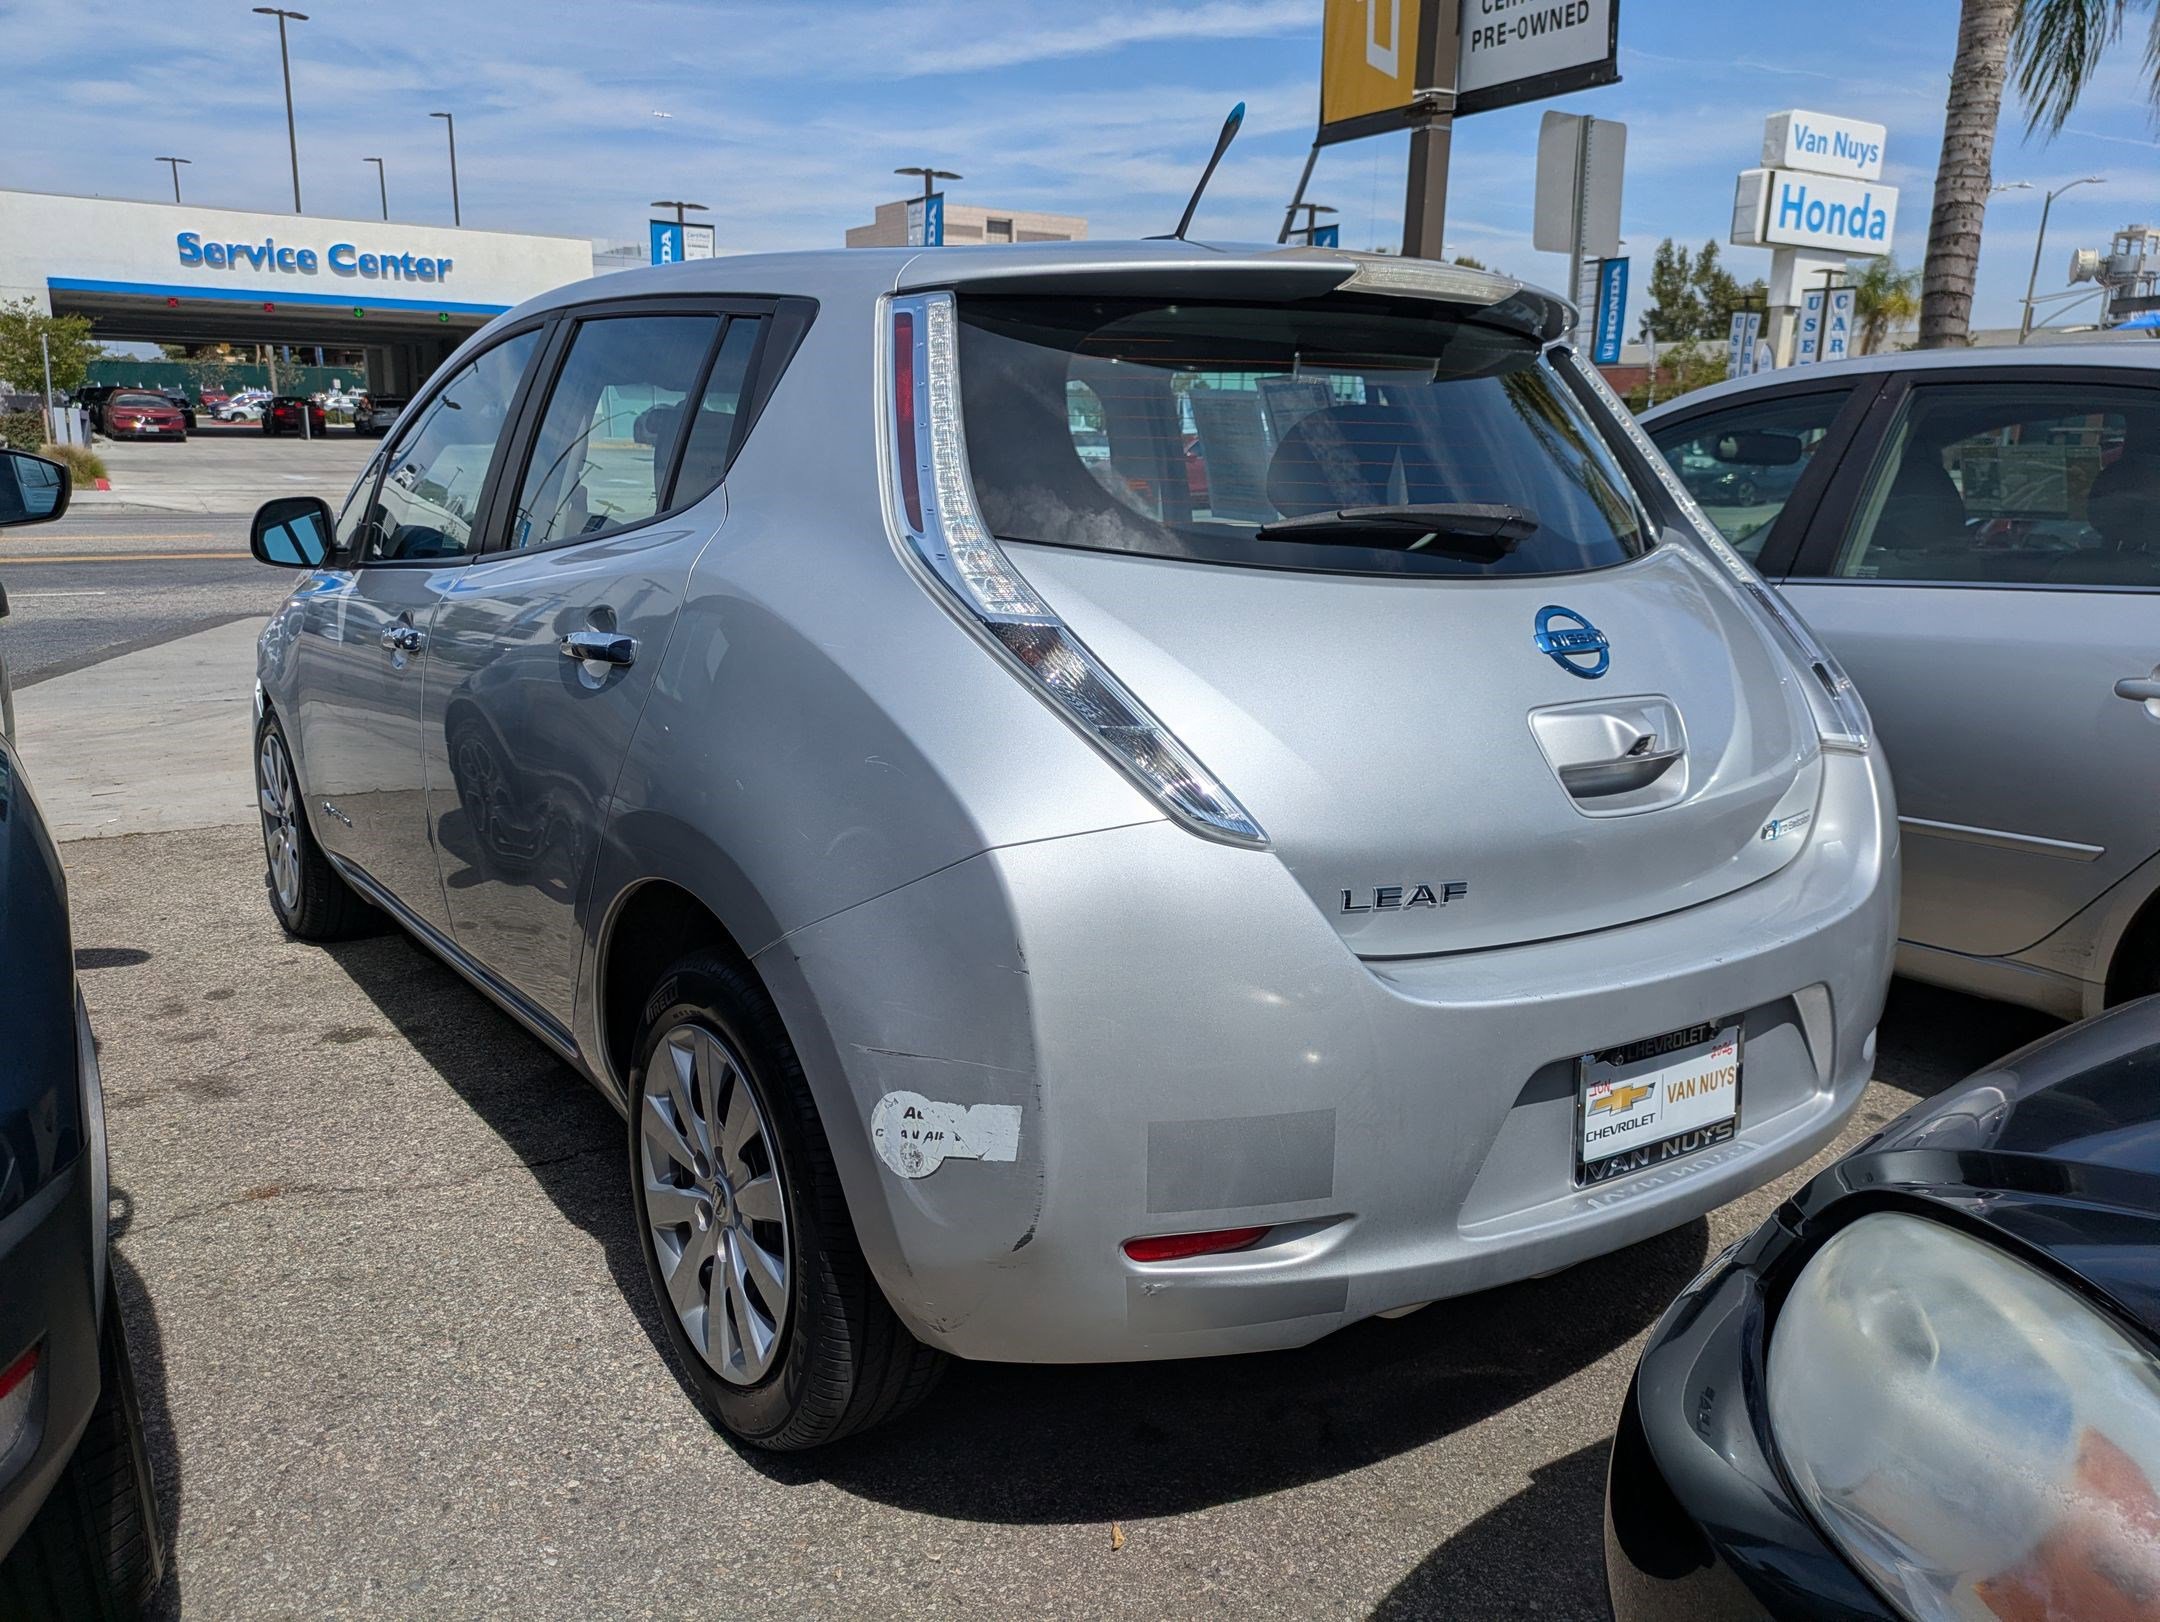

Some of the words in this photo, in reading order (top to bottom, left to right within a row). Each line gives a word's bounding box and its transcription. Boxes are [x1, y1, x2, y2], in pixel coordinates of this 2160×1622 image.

[1472, 0, 1589, 53] PRE-OWNED
[1794, 123, 1828, 155] Van
[1833, 131, 1879, 169] Nuys
[1778, 184, 1886, 241] Honda
[177, 232, 318, 272] Service
[328, 243, 453, 281] Center
[1606, 265, 1622, 340] HONDA
[1800, 296, 1822, 364] USE
[1340, 882, 1467, 912] LEAF
[1627, 1025, 1707, 1061] CHEVROLET
[1667, 1077, 1696, 1105] VAN
[1699, 1066, 1735, 1095] NUYS
[1586, 1113, 1655, 1143] CHEVROLET
[1588, 1147, 1650, 1180] VAN
[1661, 1120, 1733, 1160] NUYS
